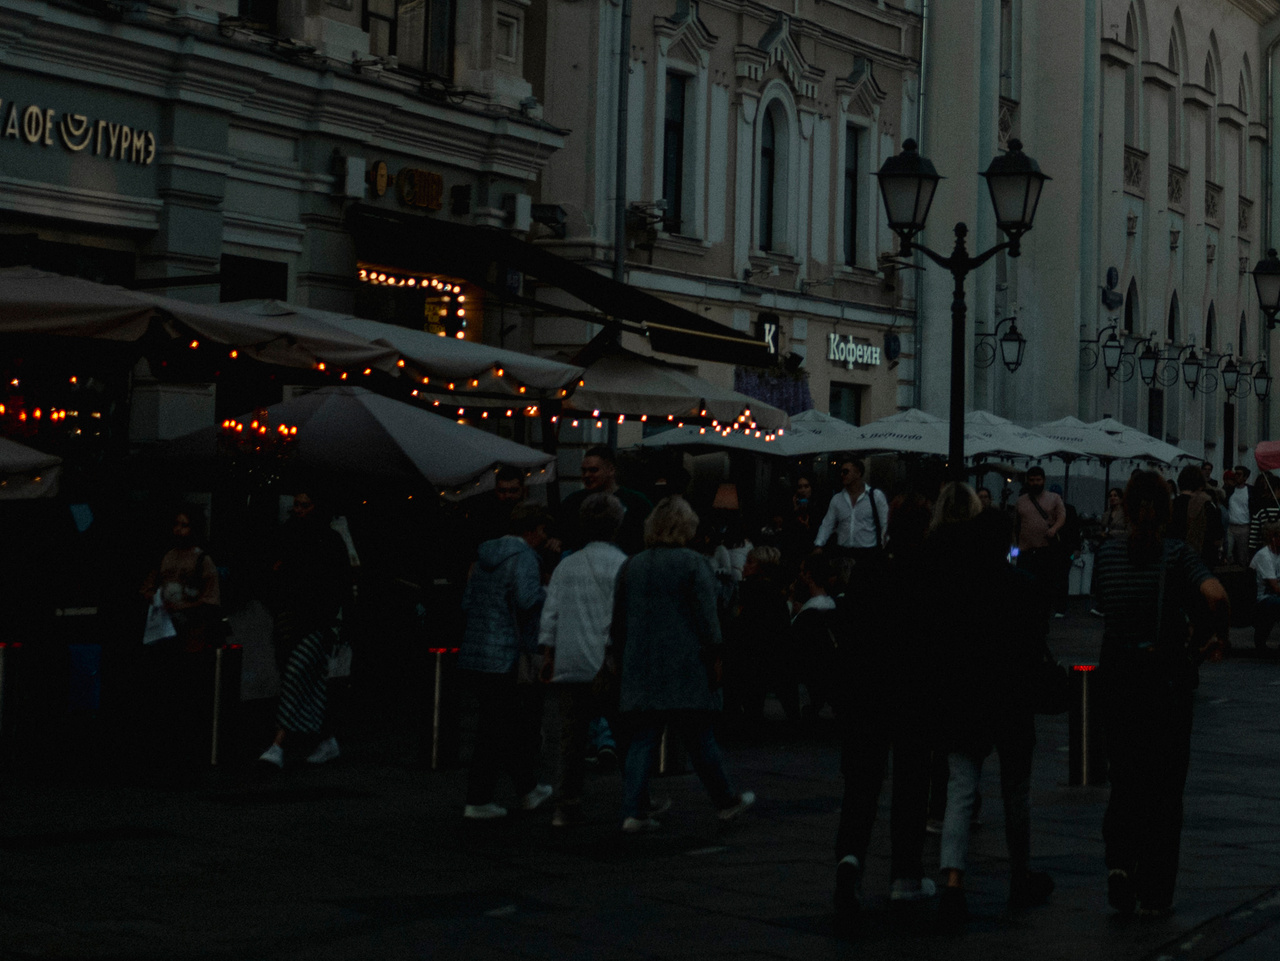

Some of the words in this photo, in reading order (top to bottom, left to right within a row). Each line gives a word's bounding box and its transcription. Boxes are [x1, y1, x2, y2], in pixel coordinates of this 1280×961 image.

[0, 98, 56, 146] АФЕ
[96, 120, 157, 165] ГУРМЭ
[829, 333, 881, 370] Кофеин
